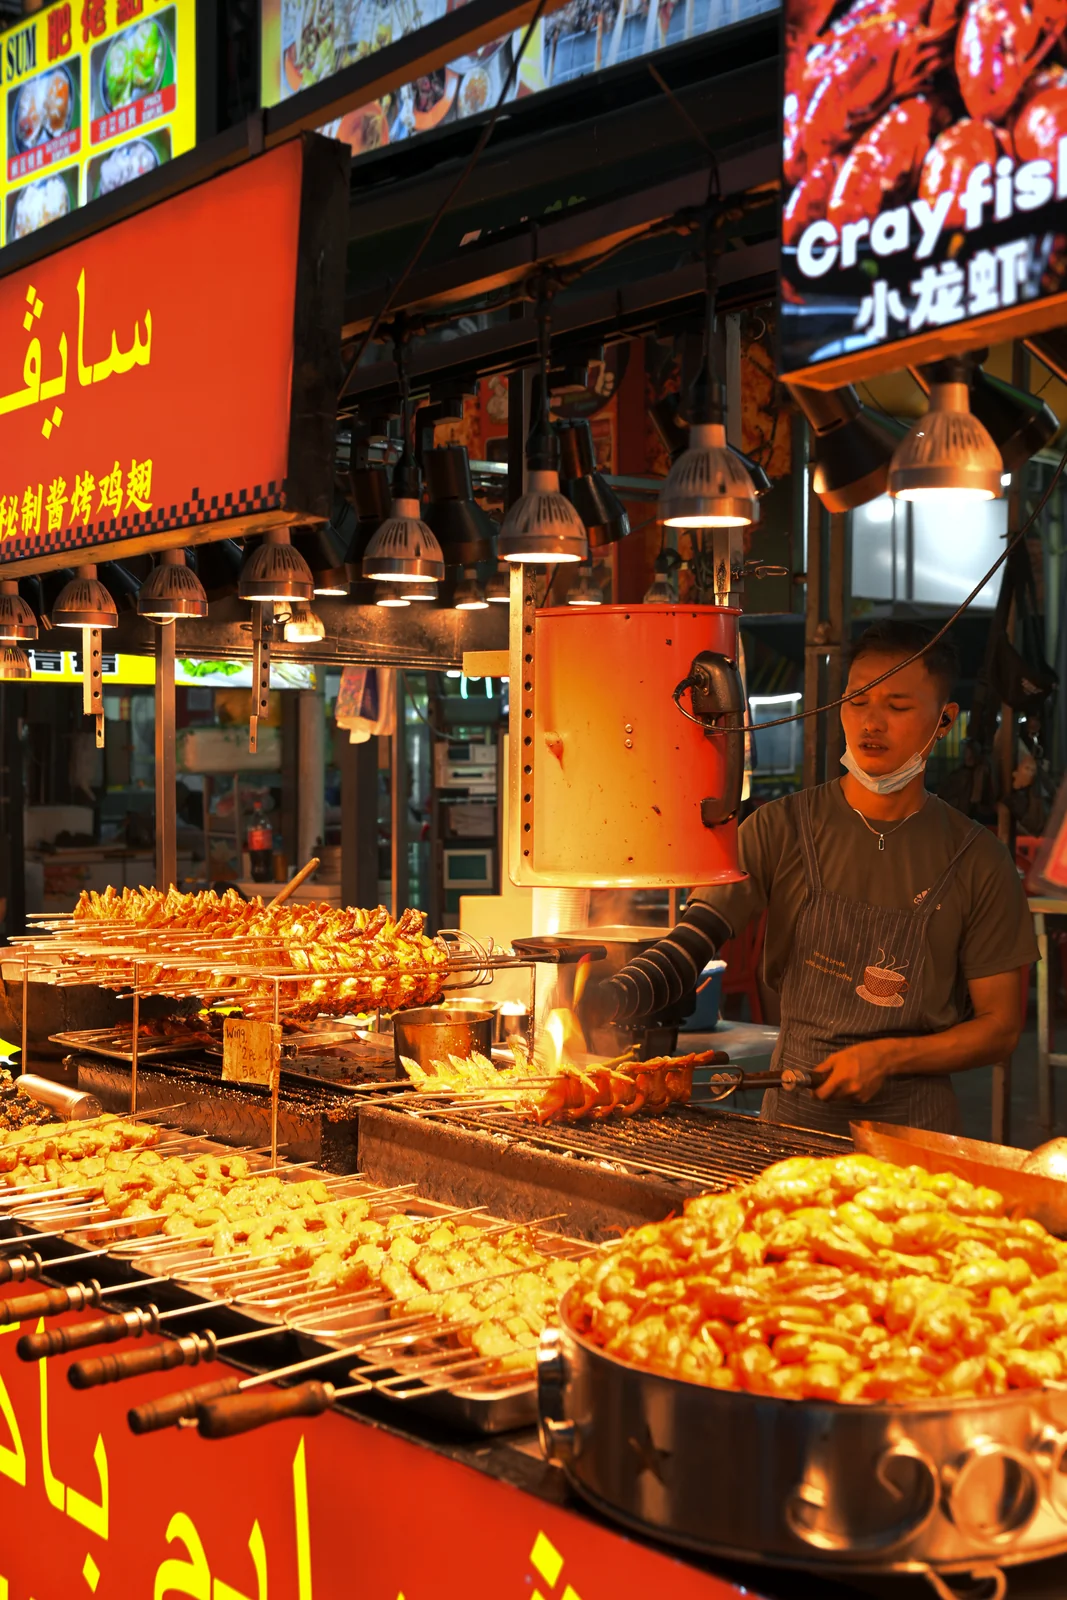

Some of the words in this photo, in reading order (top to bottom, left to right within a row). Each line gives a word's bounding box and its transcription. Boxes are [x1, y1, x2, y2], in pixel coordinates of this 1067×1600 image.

[6, 23, 37, 82] SUM
[796, 190, 955, 278] Cray
[853, 238, 1029, 341] 小龙虾
[0, 459, 153, 541] 秘制酱烤鸡翅
[226, 1026, 246, 1043] Wing
